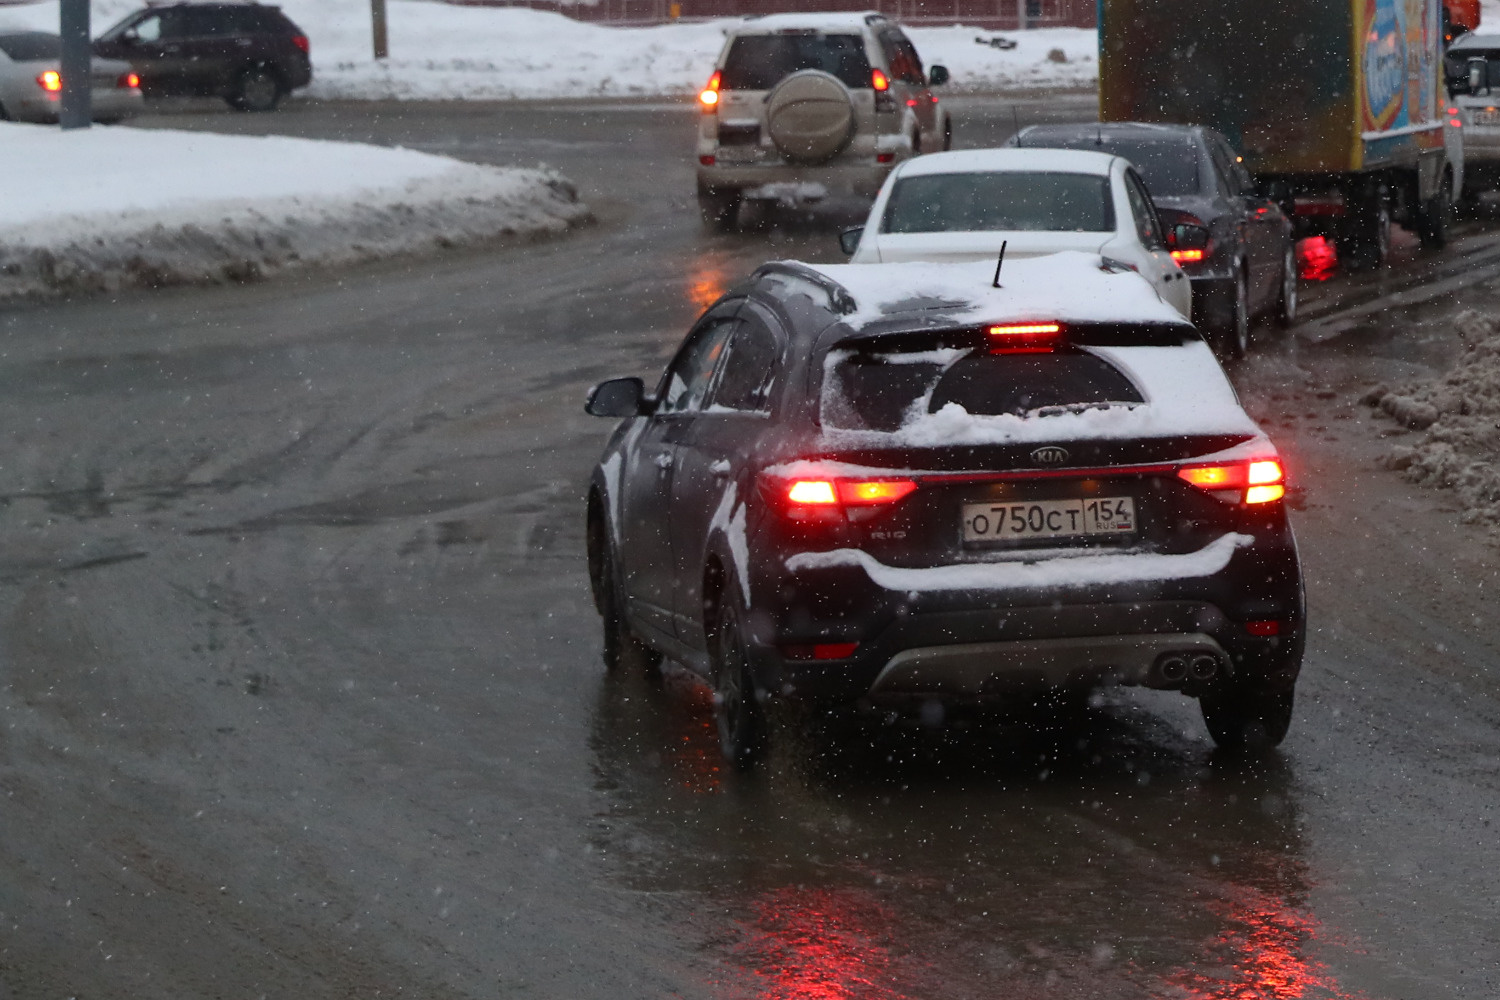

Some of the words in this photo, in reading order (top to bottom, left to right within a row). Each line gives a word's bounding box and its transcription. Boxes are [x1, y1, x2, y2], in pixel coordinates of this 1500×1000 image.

[1037, 450, 1064, 462] KIA
[1087, 499, 1129, 521] 154
[1097, 521, 1117, 530] RUS
[871, 531, 907, 540] RIO
